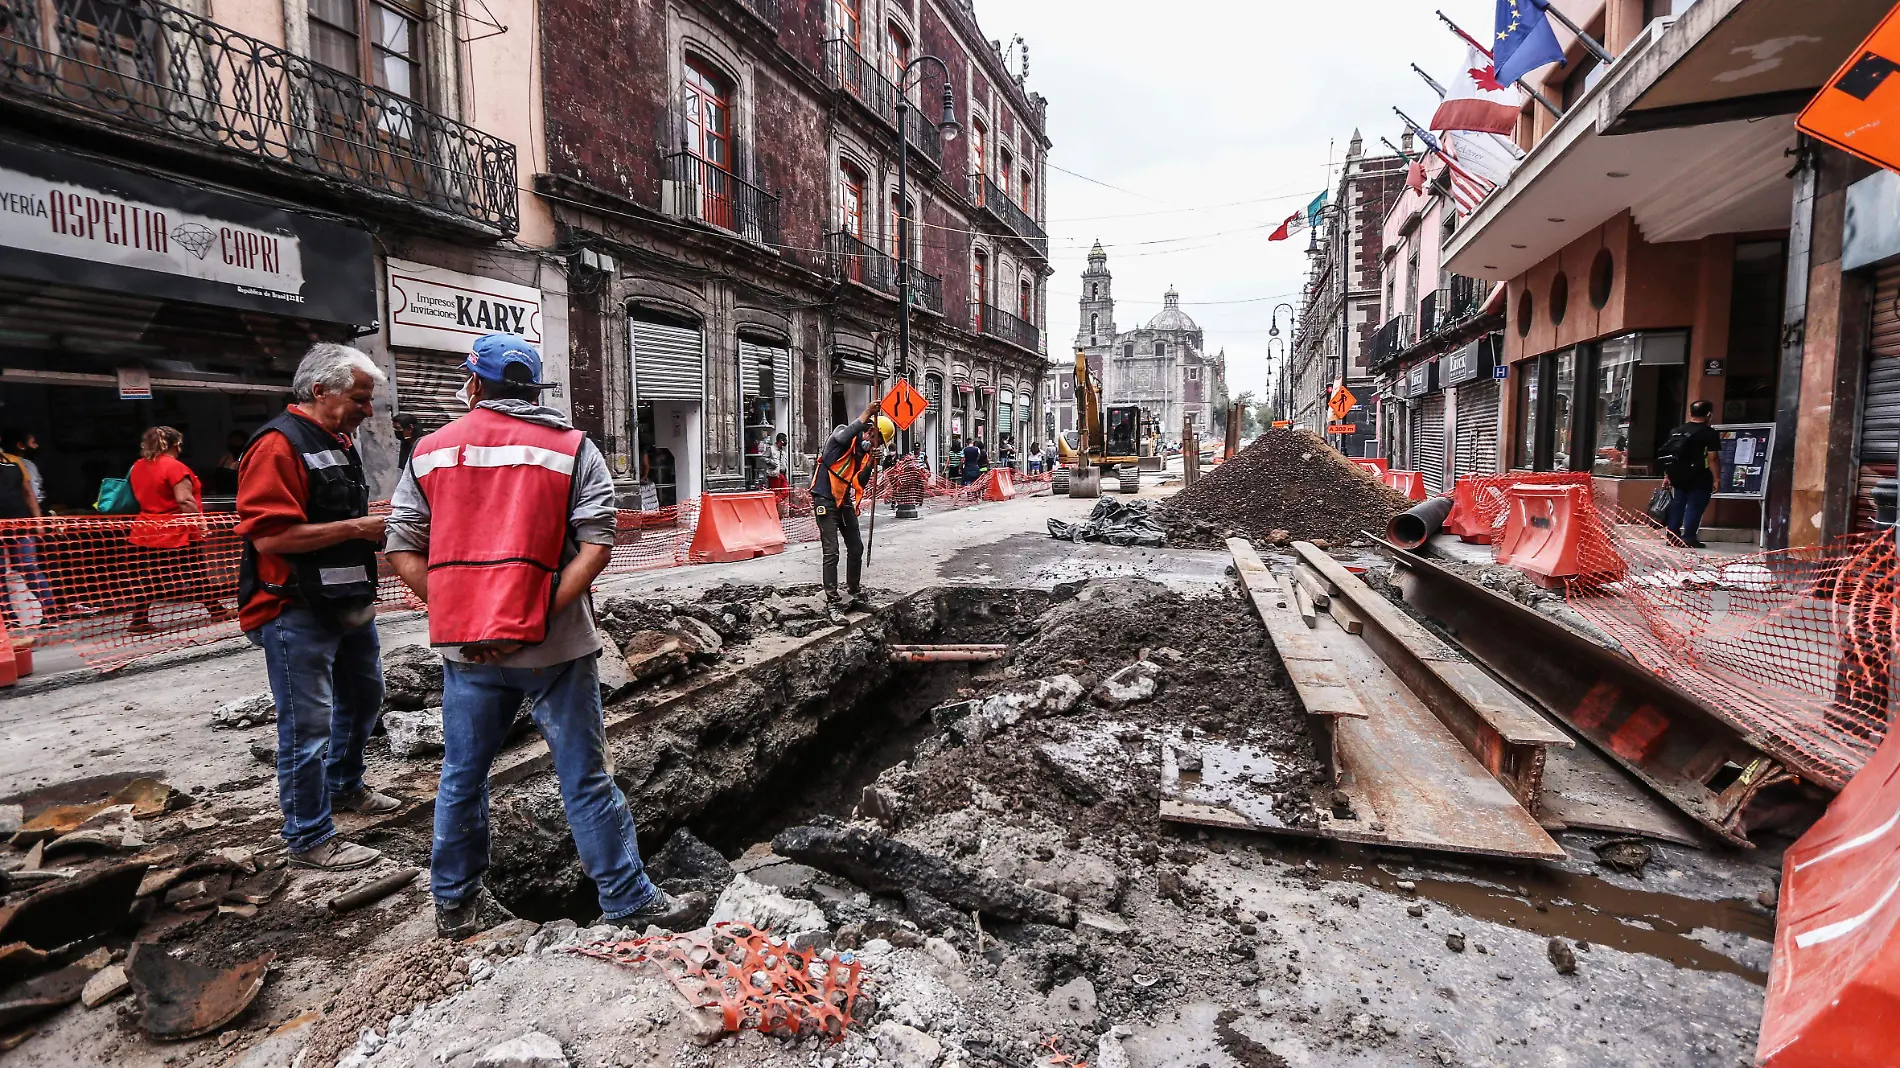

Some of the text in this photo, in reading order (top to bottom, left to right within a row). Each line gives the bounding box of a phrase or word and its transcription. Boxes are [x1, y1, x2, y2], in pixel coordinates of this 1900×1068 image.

[50, 189, 168, 253] ASPEITIA
[220, 227, 279, 274] CAPRI
[416, 292, 456, 309] Impresos
[410, 302, 457, 320] Invitaciones
[455, 295, 525, 335] KARY
[1496, 367, 1505, 377] H
